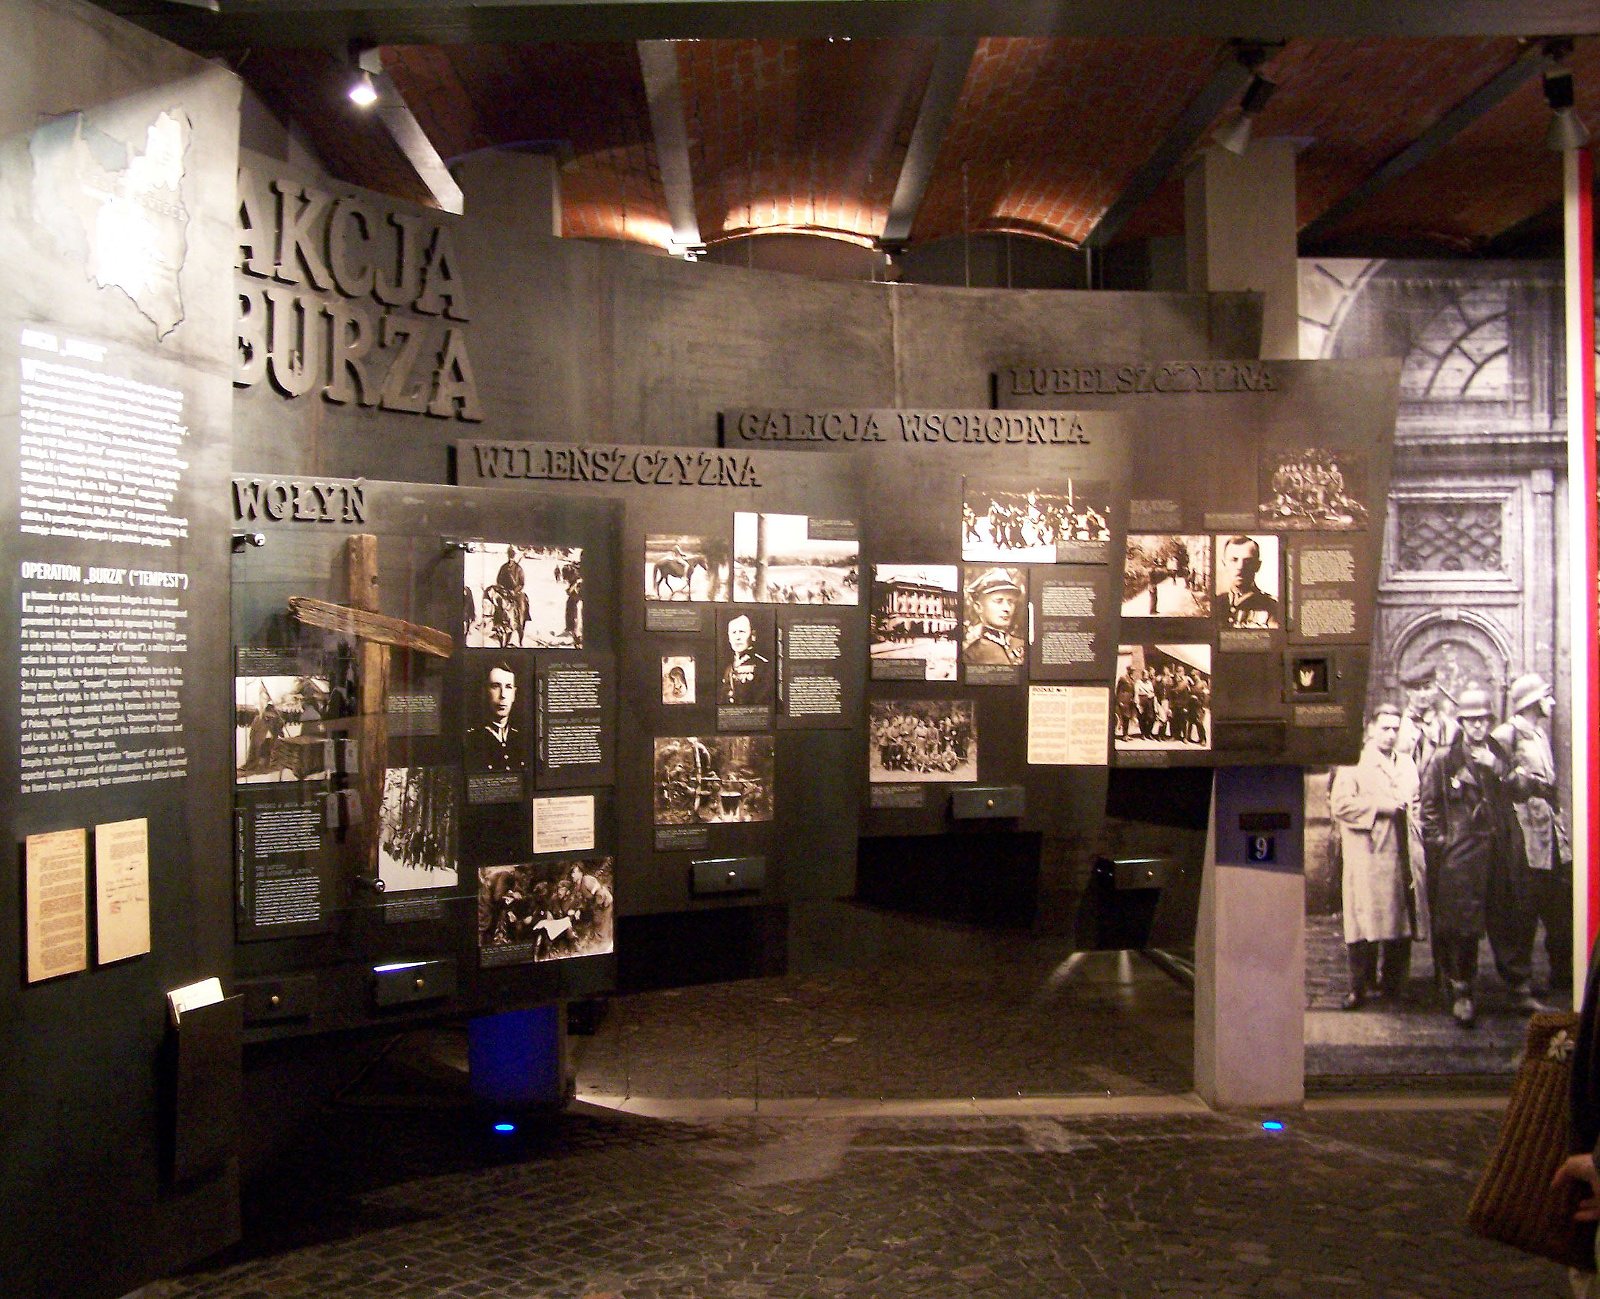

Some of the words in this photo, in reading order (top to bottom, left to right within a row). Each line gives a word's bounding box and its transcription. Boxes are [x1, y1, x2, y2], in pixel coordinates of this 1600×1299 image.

[233, 168, 470, 322] AKCJA
[233, 288, 482, 423] BURZA
[1010, 363, 1278, 396] LUBELSZCZYZNA
[738, 410, 887, 442] GALICJA
[897, 412, 1090, 445] WSCHODNIA
[22, 562, 81, 582] OPERATION
[1256, 837, 1268, 859] 9
